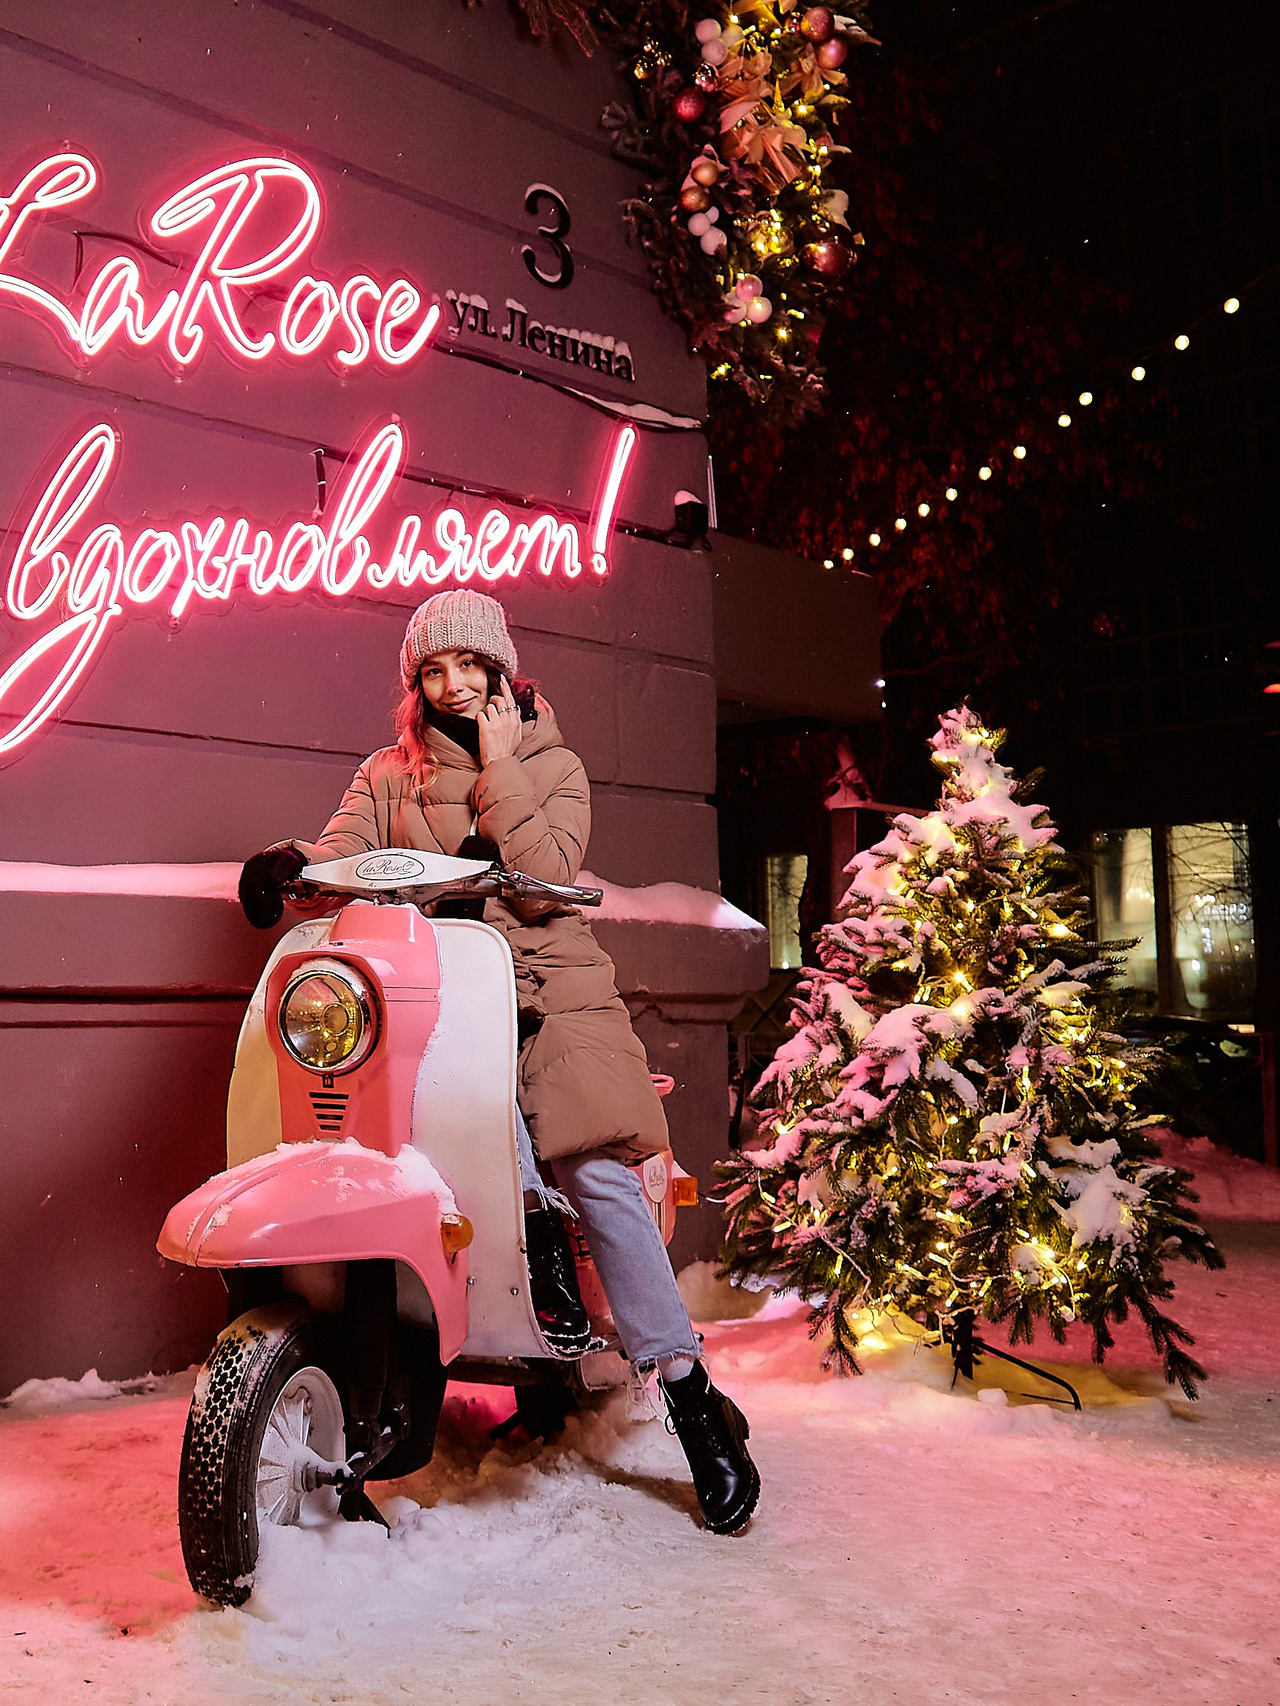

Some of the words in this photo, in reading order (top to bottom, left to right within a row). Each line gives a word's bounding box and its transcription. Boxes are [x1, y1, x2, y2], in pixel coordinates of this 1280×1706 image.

[522, 184, 574, 289] 3
[447, 294, 497, 338] ул.
[502, 303, 635, 382] Ленина
